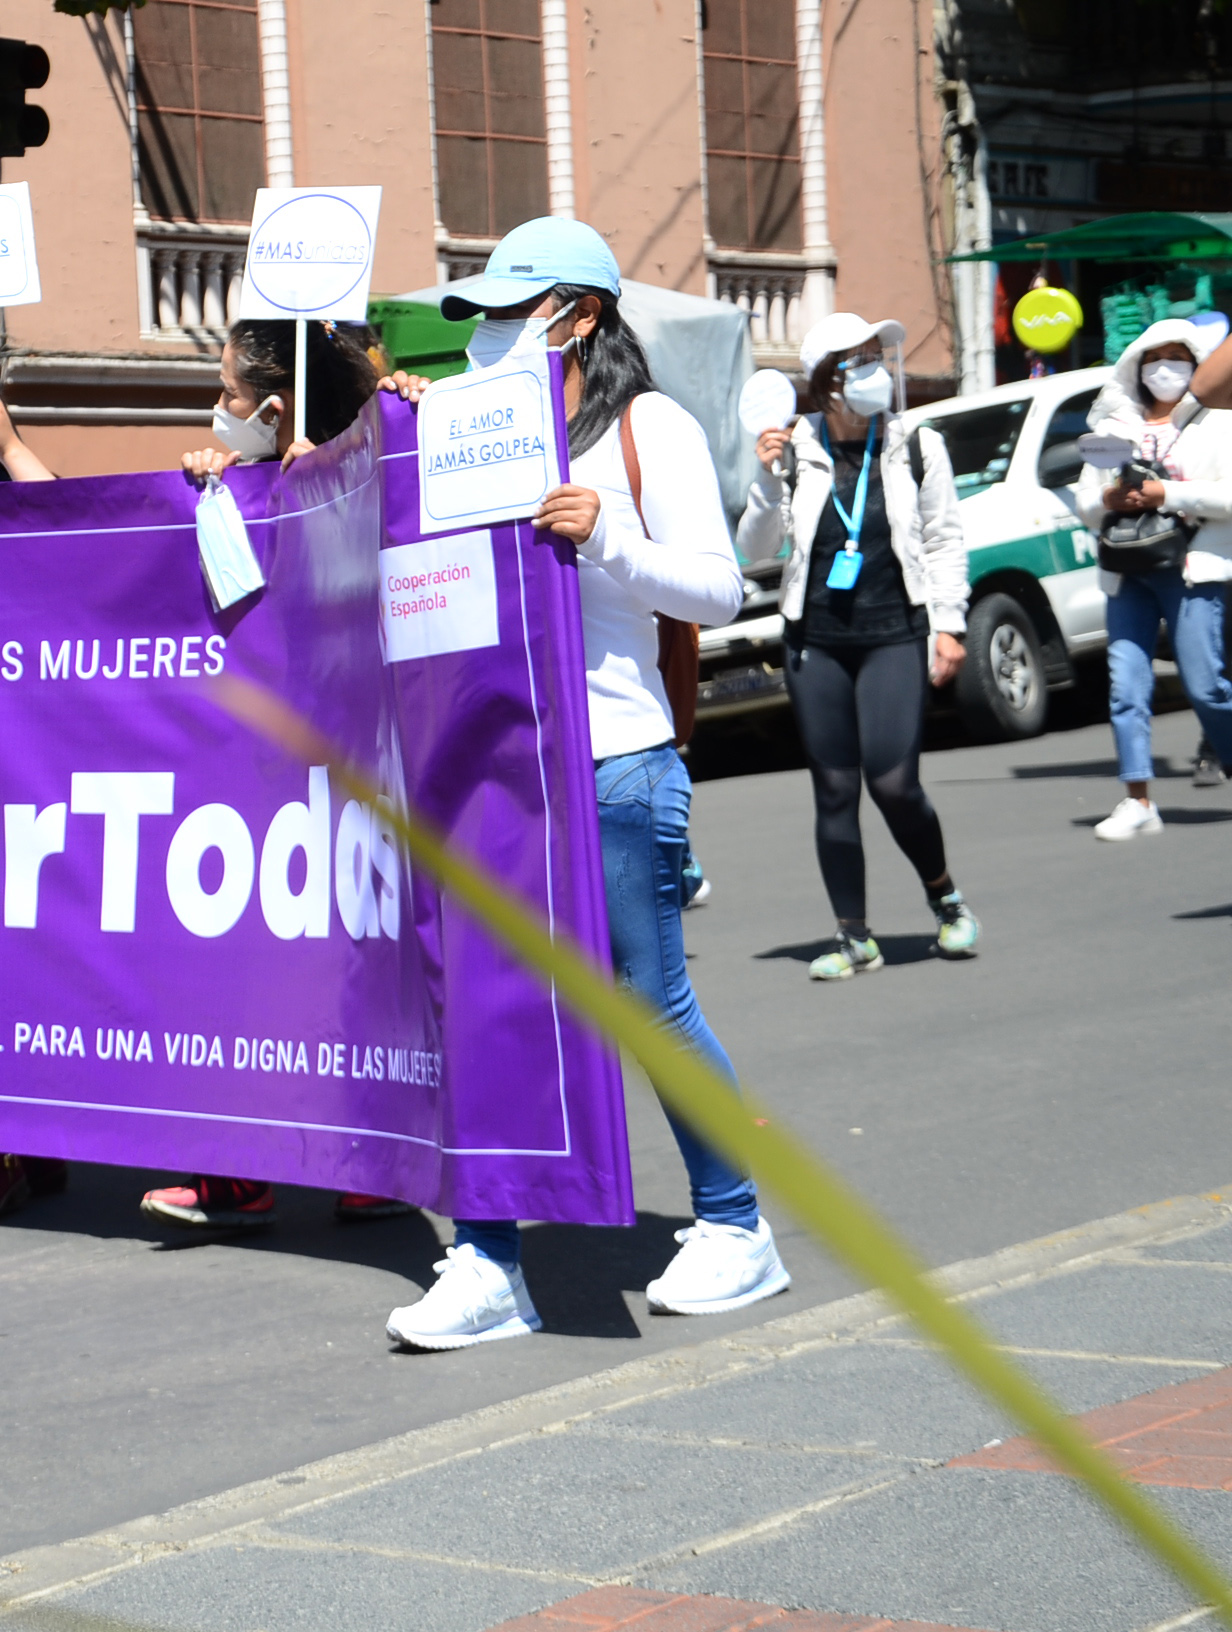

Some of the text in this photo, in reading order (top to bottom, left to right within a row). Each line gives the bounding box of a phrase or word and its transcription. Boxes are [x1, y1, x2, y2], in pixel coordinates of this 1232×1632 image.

[254, 241, 365, 260] #MASunidas
[449, 407, 514, 436] EL AMOR
[427, 435, 544, 473] JAMÁS GOLPEA
[387, 563, 471, 594] Cooperación
[390, 592, 447, 620] Española
[39, 634, 227, 681] MUJERES
[15, 1021, 86, 1058] PARA
[96, 1028, 155, 1063] UNA
[164, 1031, 225, 1069] VIDA
[233, 1036, 310, 1075] DIGNA
[317, 1042, 346, 1078] DE
[351, 1044, 385, 1081] LAS
[387, 1047, 442, 1088] MUJERES
